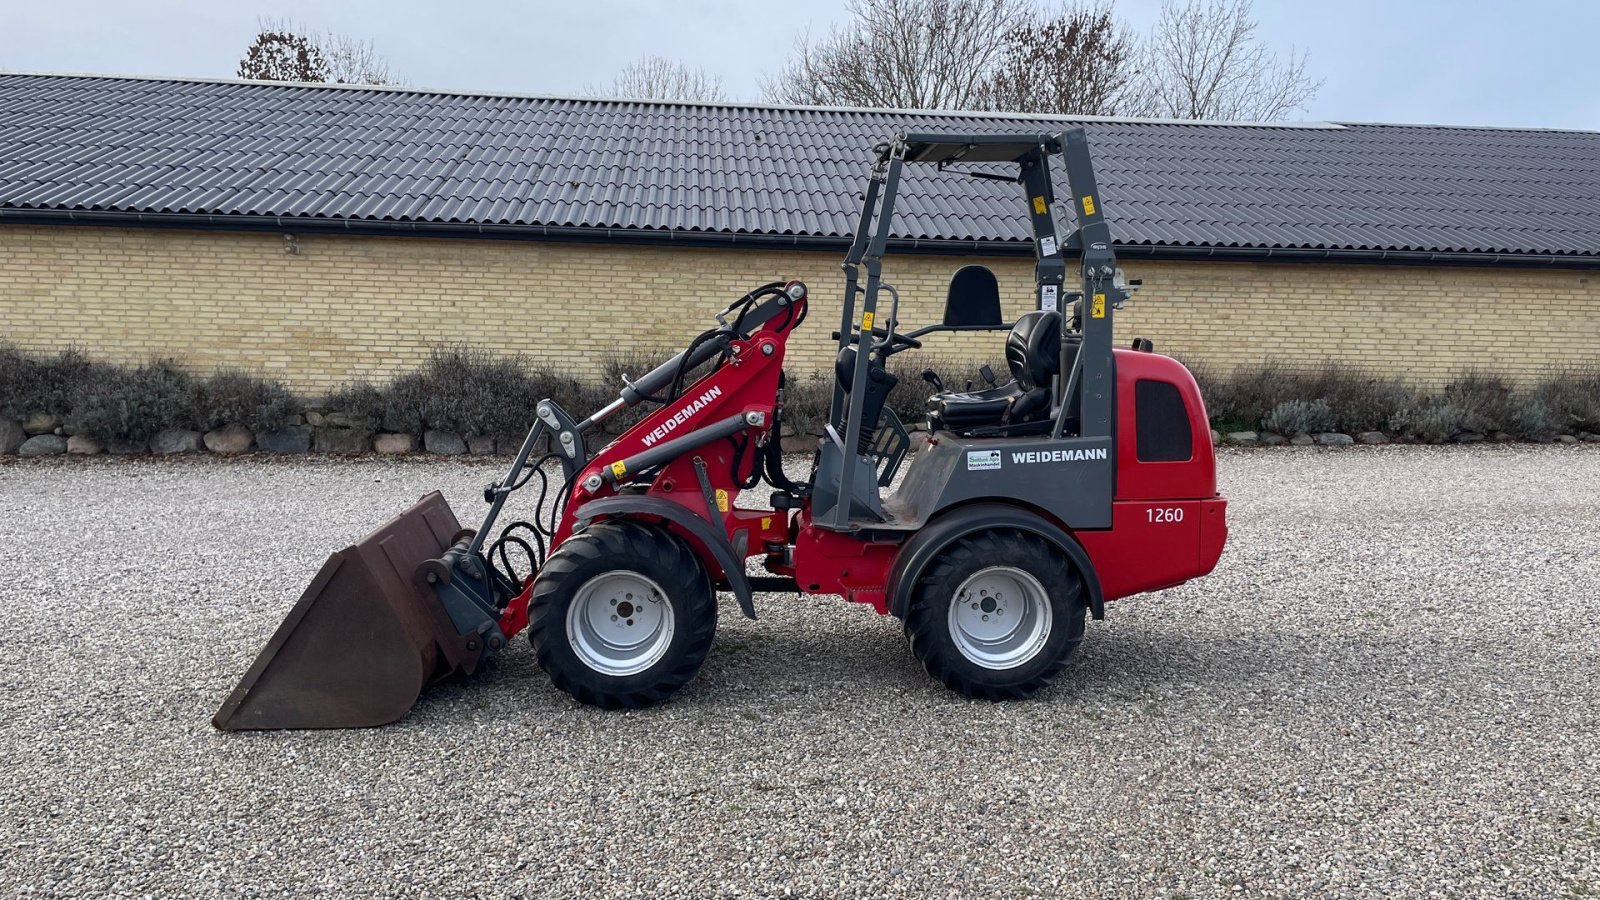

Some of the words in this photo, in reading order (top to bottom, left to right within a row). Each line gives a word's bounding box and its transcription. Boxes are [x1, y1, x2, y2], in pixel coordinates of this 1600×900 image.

[641, 385, 722, 447] WEIDEMANN
[1012, 448, 1107, 464] WEIDEMANN
[1146, 508, 1184, 523] 1260
